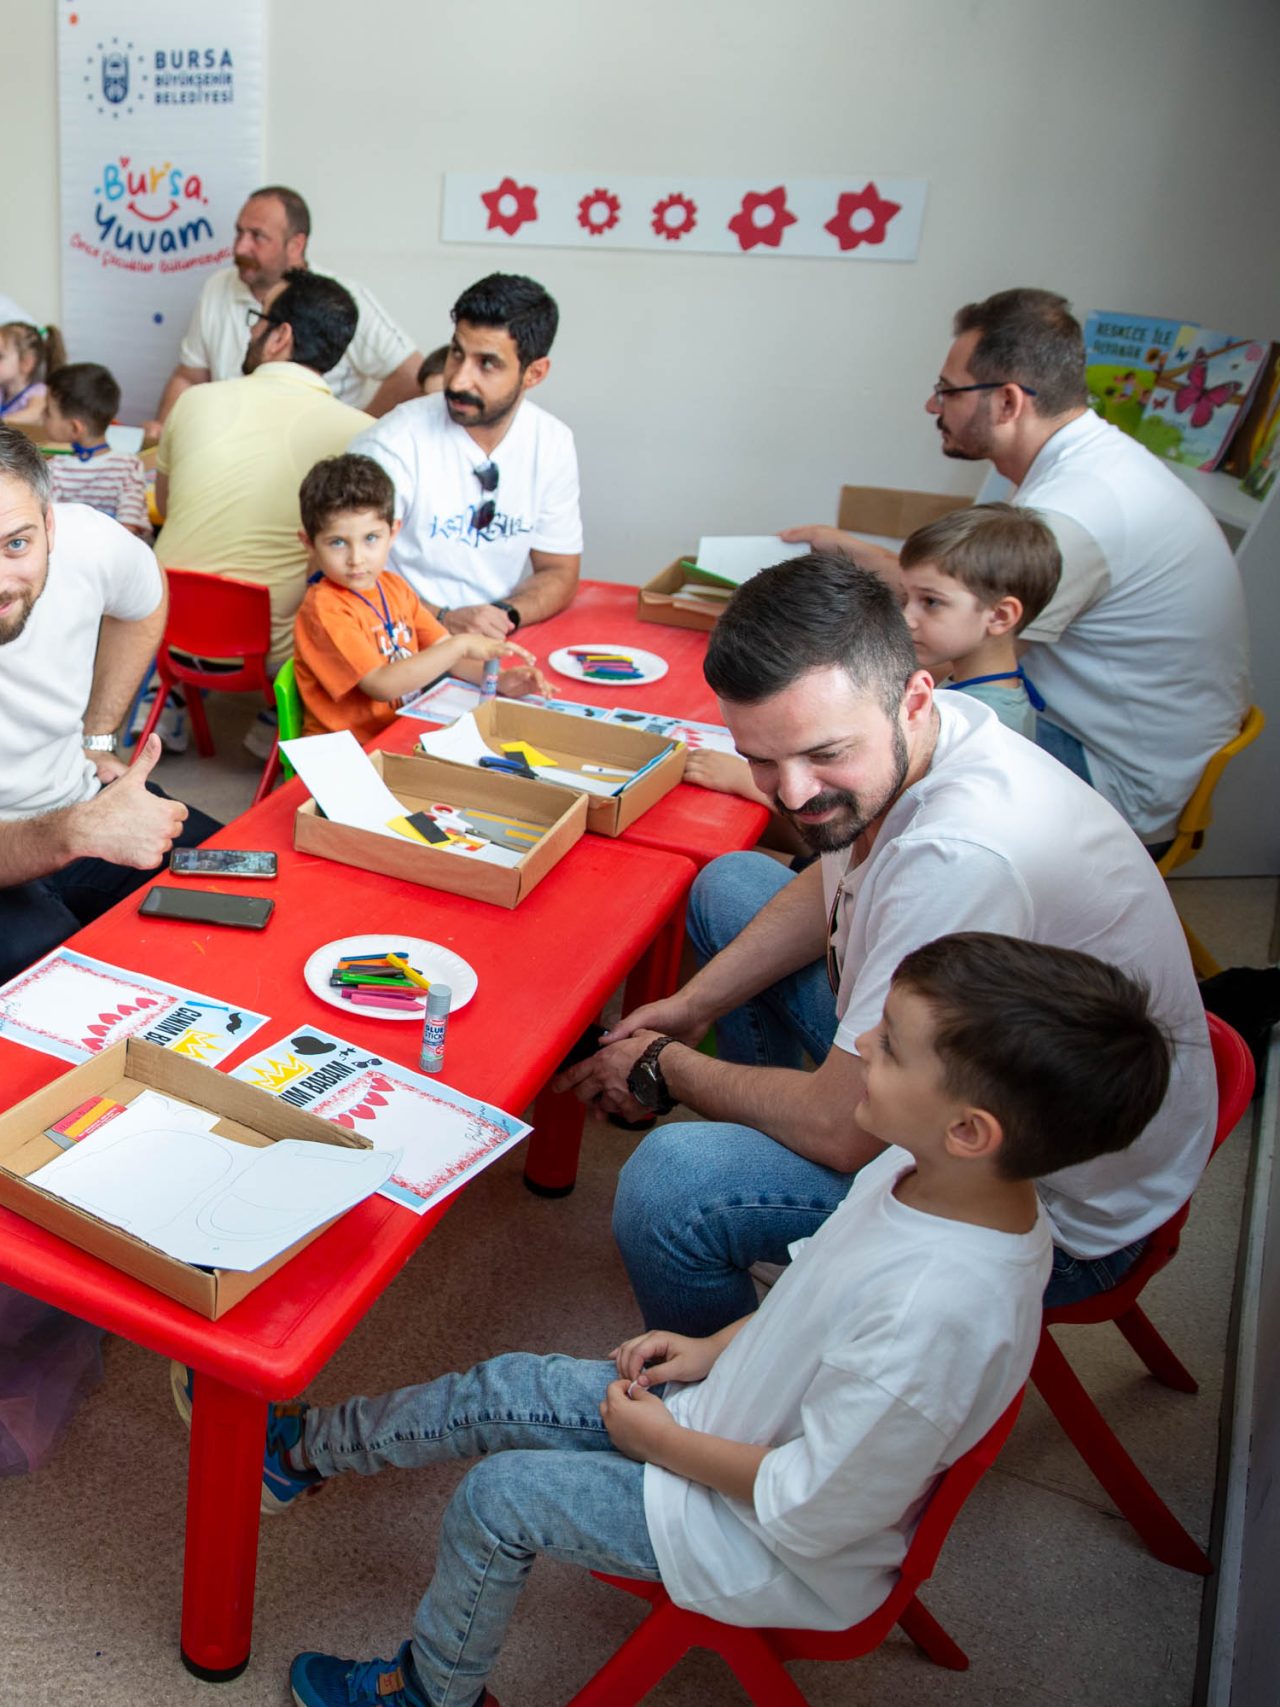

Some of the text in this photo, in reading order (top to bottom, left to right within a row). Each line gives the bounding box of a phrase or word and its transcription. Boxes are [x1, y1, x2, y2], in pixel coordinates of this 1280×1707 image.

[154, 48, 232, 69] BURSA
[154, 89, 233, 104] BELEDİYESİ
[102, 163, 203, 201] Bursa
[95, 202, 213, 254] Yuvam
[154, 1007, 202, 1036] CANIM
[425, 1024, 443, 1033] GLUE
[299, 1060, 356, 1094] BABAM
